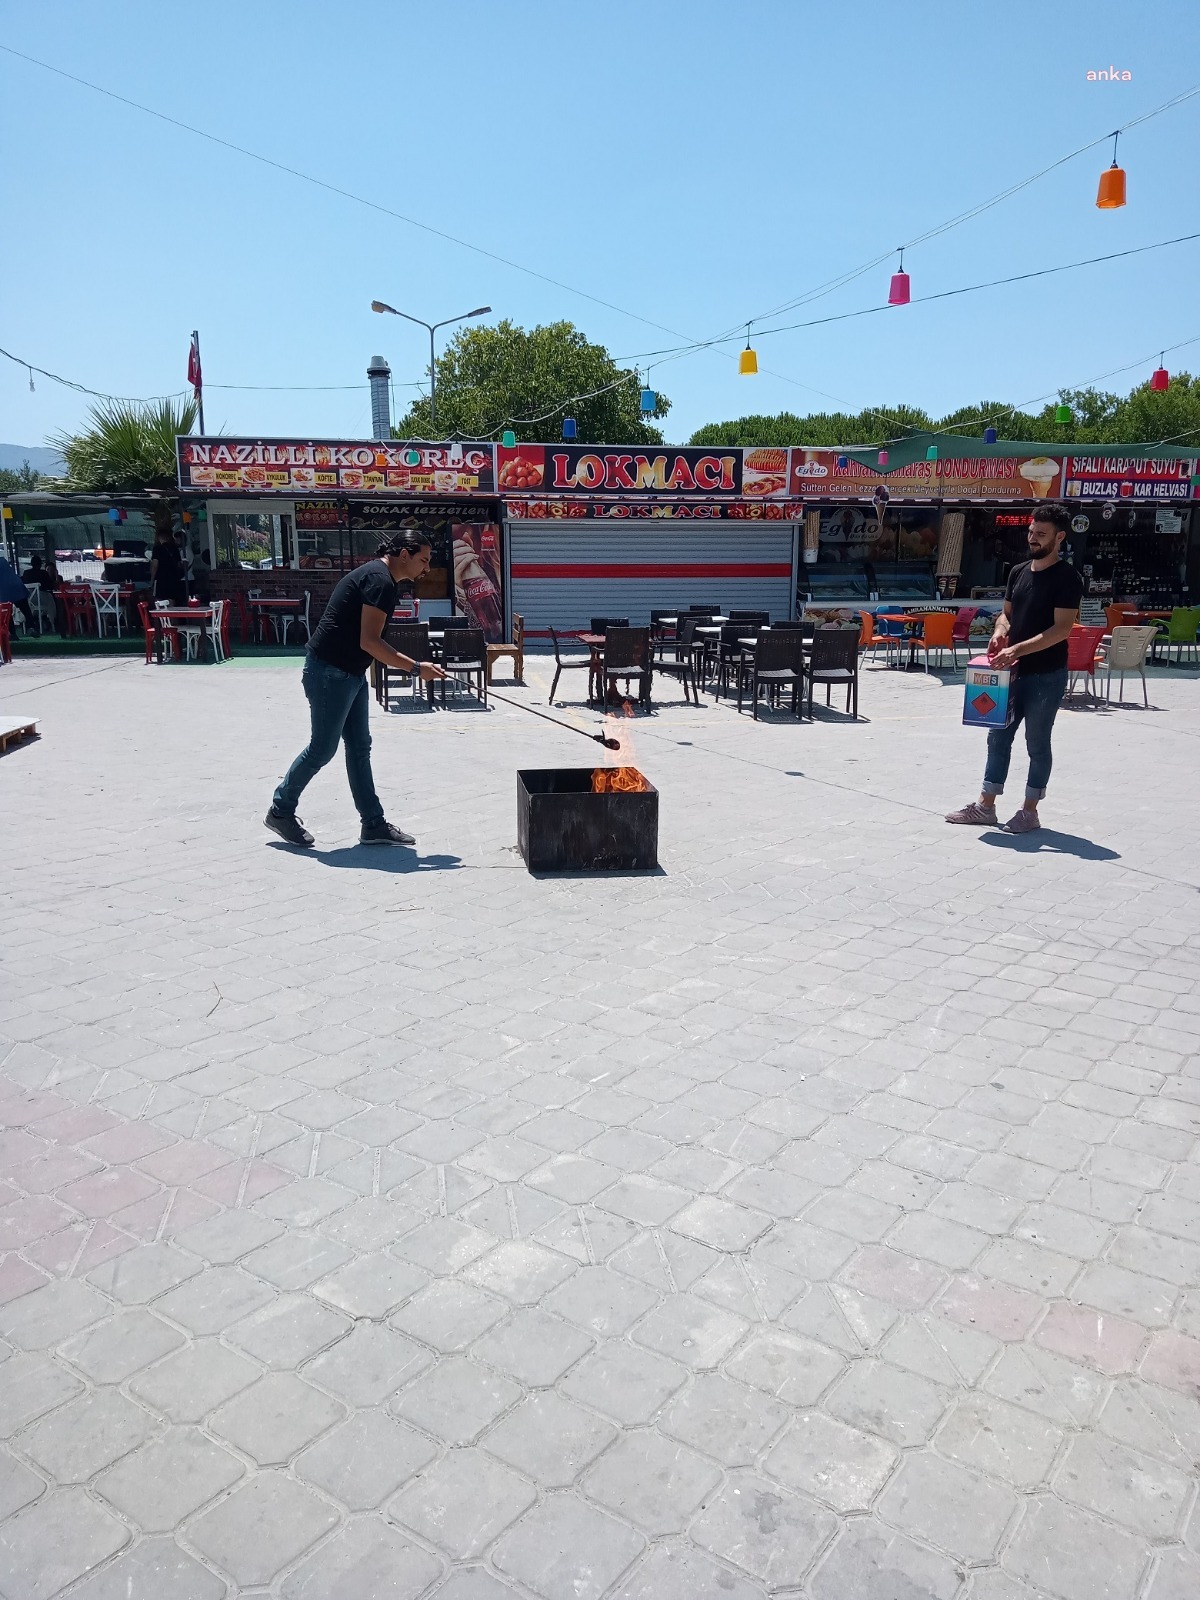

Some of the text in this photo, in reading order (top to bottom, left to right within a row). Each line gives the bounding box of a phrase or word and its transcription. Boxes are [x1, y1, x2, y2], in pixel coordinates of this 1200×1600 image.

[190, 441, 316, 466] NAZİLLİ
[552, 454, 736, 490] LOKMACI
[829, 482, 852, 493] Gelen
[981, 484, 1022, 495] Dondurma
[1082, 482, 1188, 498] BUZLAŞ KAR HELVASI
[362, 505, 410, 514] SOKAK
[593, 504, 722, 519] LOKMACI
